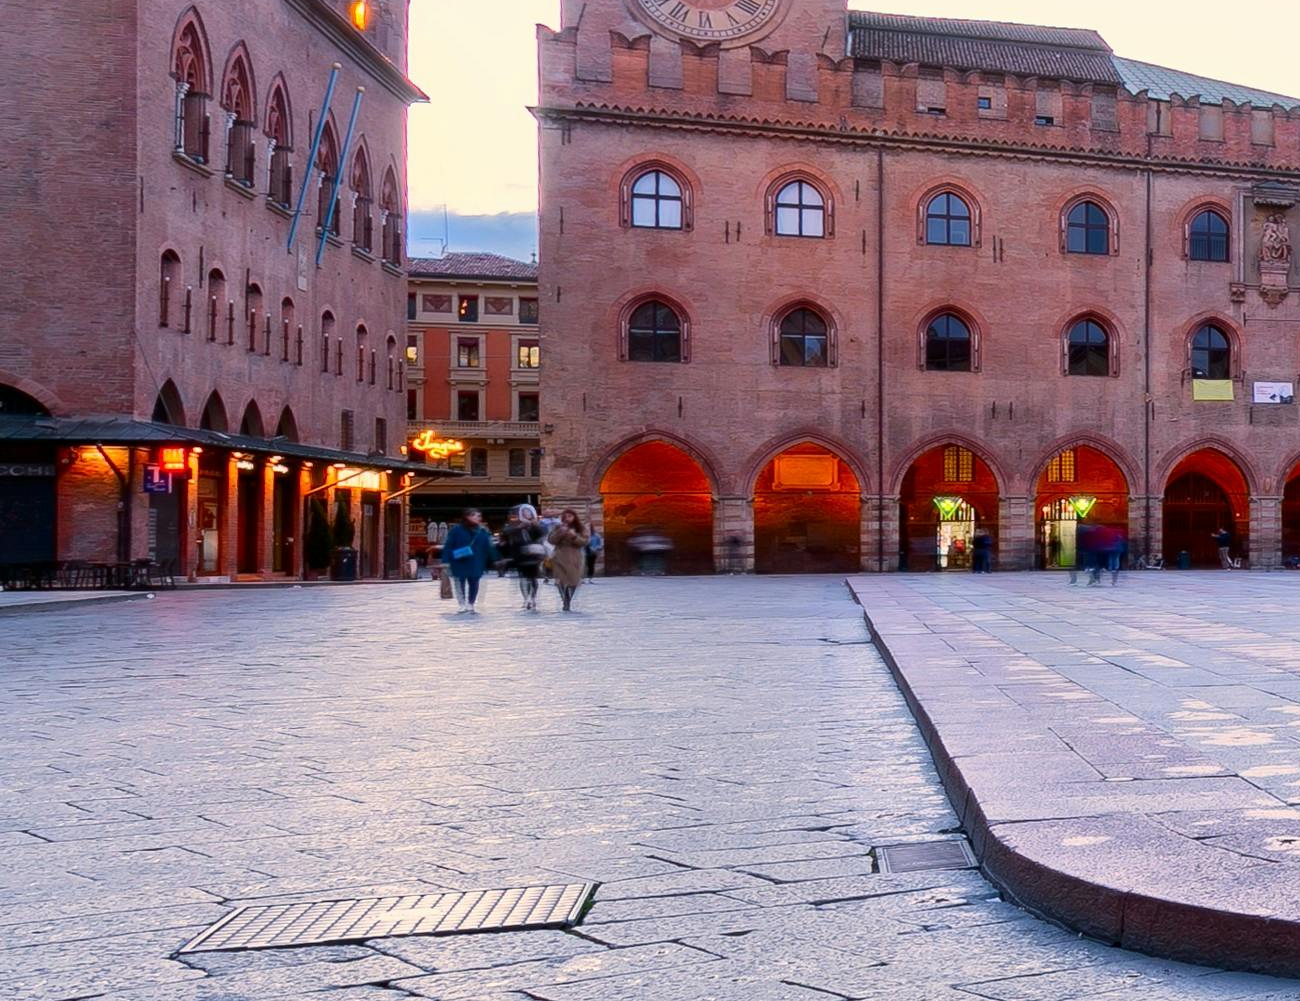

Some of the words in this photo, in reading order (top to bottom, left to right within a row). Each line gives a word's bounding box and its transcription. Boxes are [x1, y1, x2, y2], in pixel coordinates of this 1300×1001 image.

[669, 1, 690, 22] VII
[698, 11, 713, 28] VI
[725, 11, 740, 26] V
